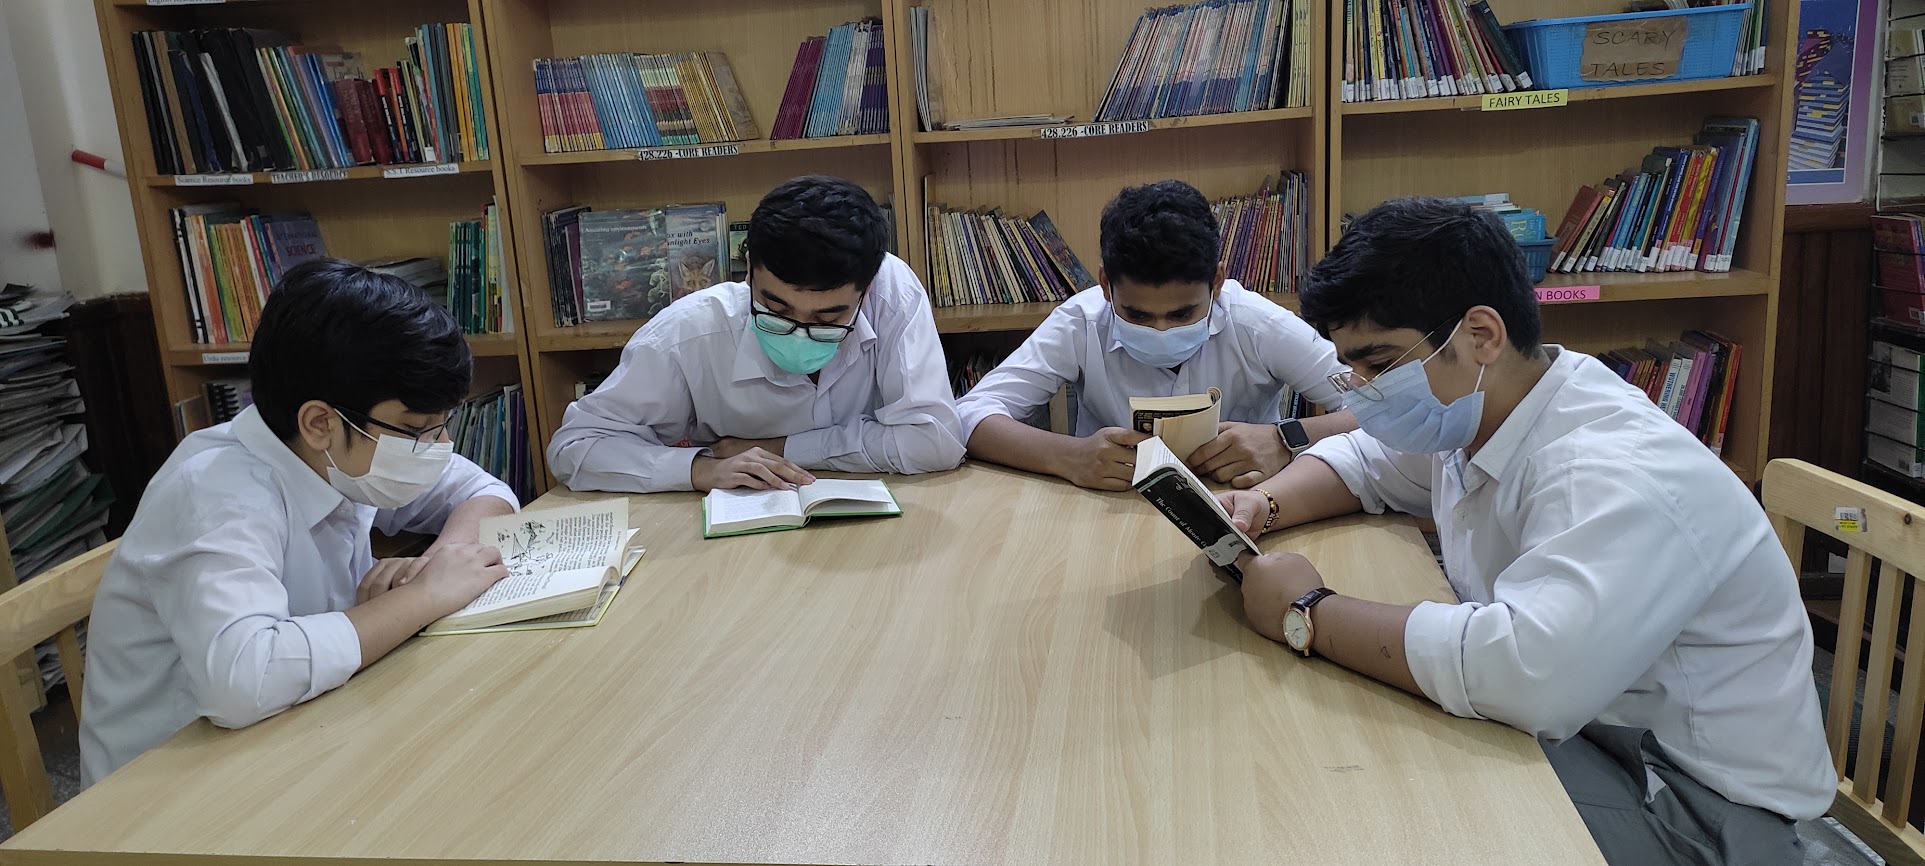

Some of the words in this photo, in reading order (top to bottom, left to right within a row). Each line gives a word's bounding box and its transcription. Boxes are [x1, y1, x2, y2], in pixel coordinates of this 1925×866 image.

[1593, 29, 1676, 50] SCARY
[1591, 62, 1665, 77] TALES
[1489, 96, 1523, 108] FAIRY
[1525, 92, 1560, 105] TALES
[1041, 127, 1078, 138] 428.226
[1108, 121, 1147, 134] READERS
[639, 150, 673, 160] 428.226
[702, 144, 738, 156] READERS
[405, 166, 435, 174] Resource
[436, 164, 456, 173] books
[667, 238, 691, 247] nlight
[693, 237, 710, 246] Eyes
[1546, 290, 1586, 300] BOOKS
[1156, 496, 1166, 507] The
[1165, 506, 1180, 521] Count
